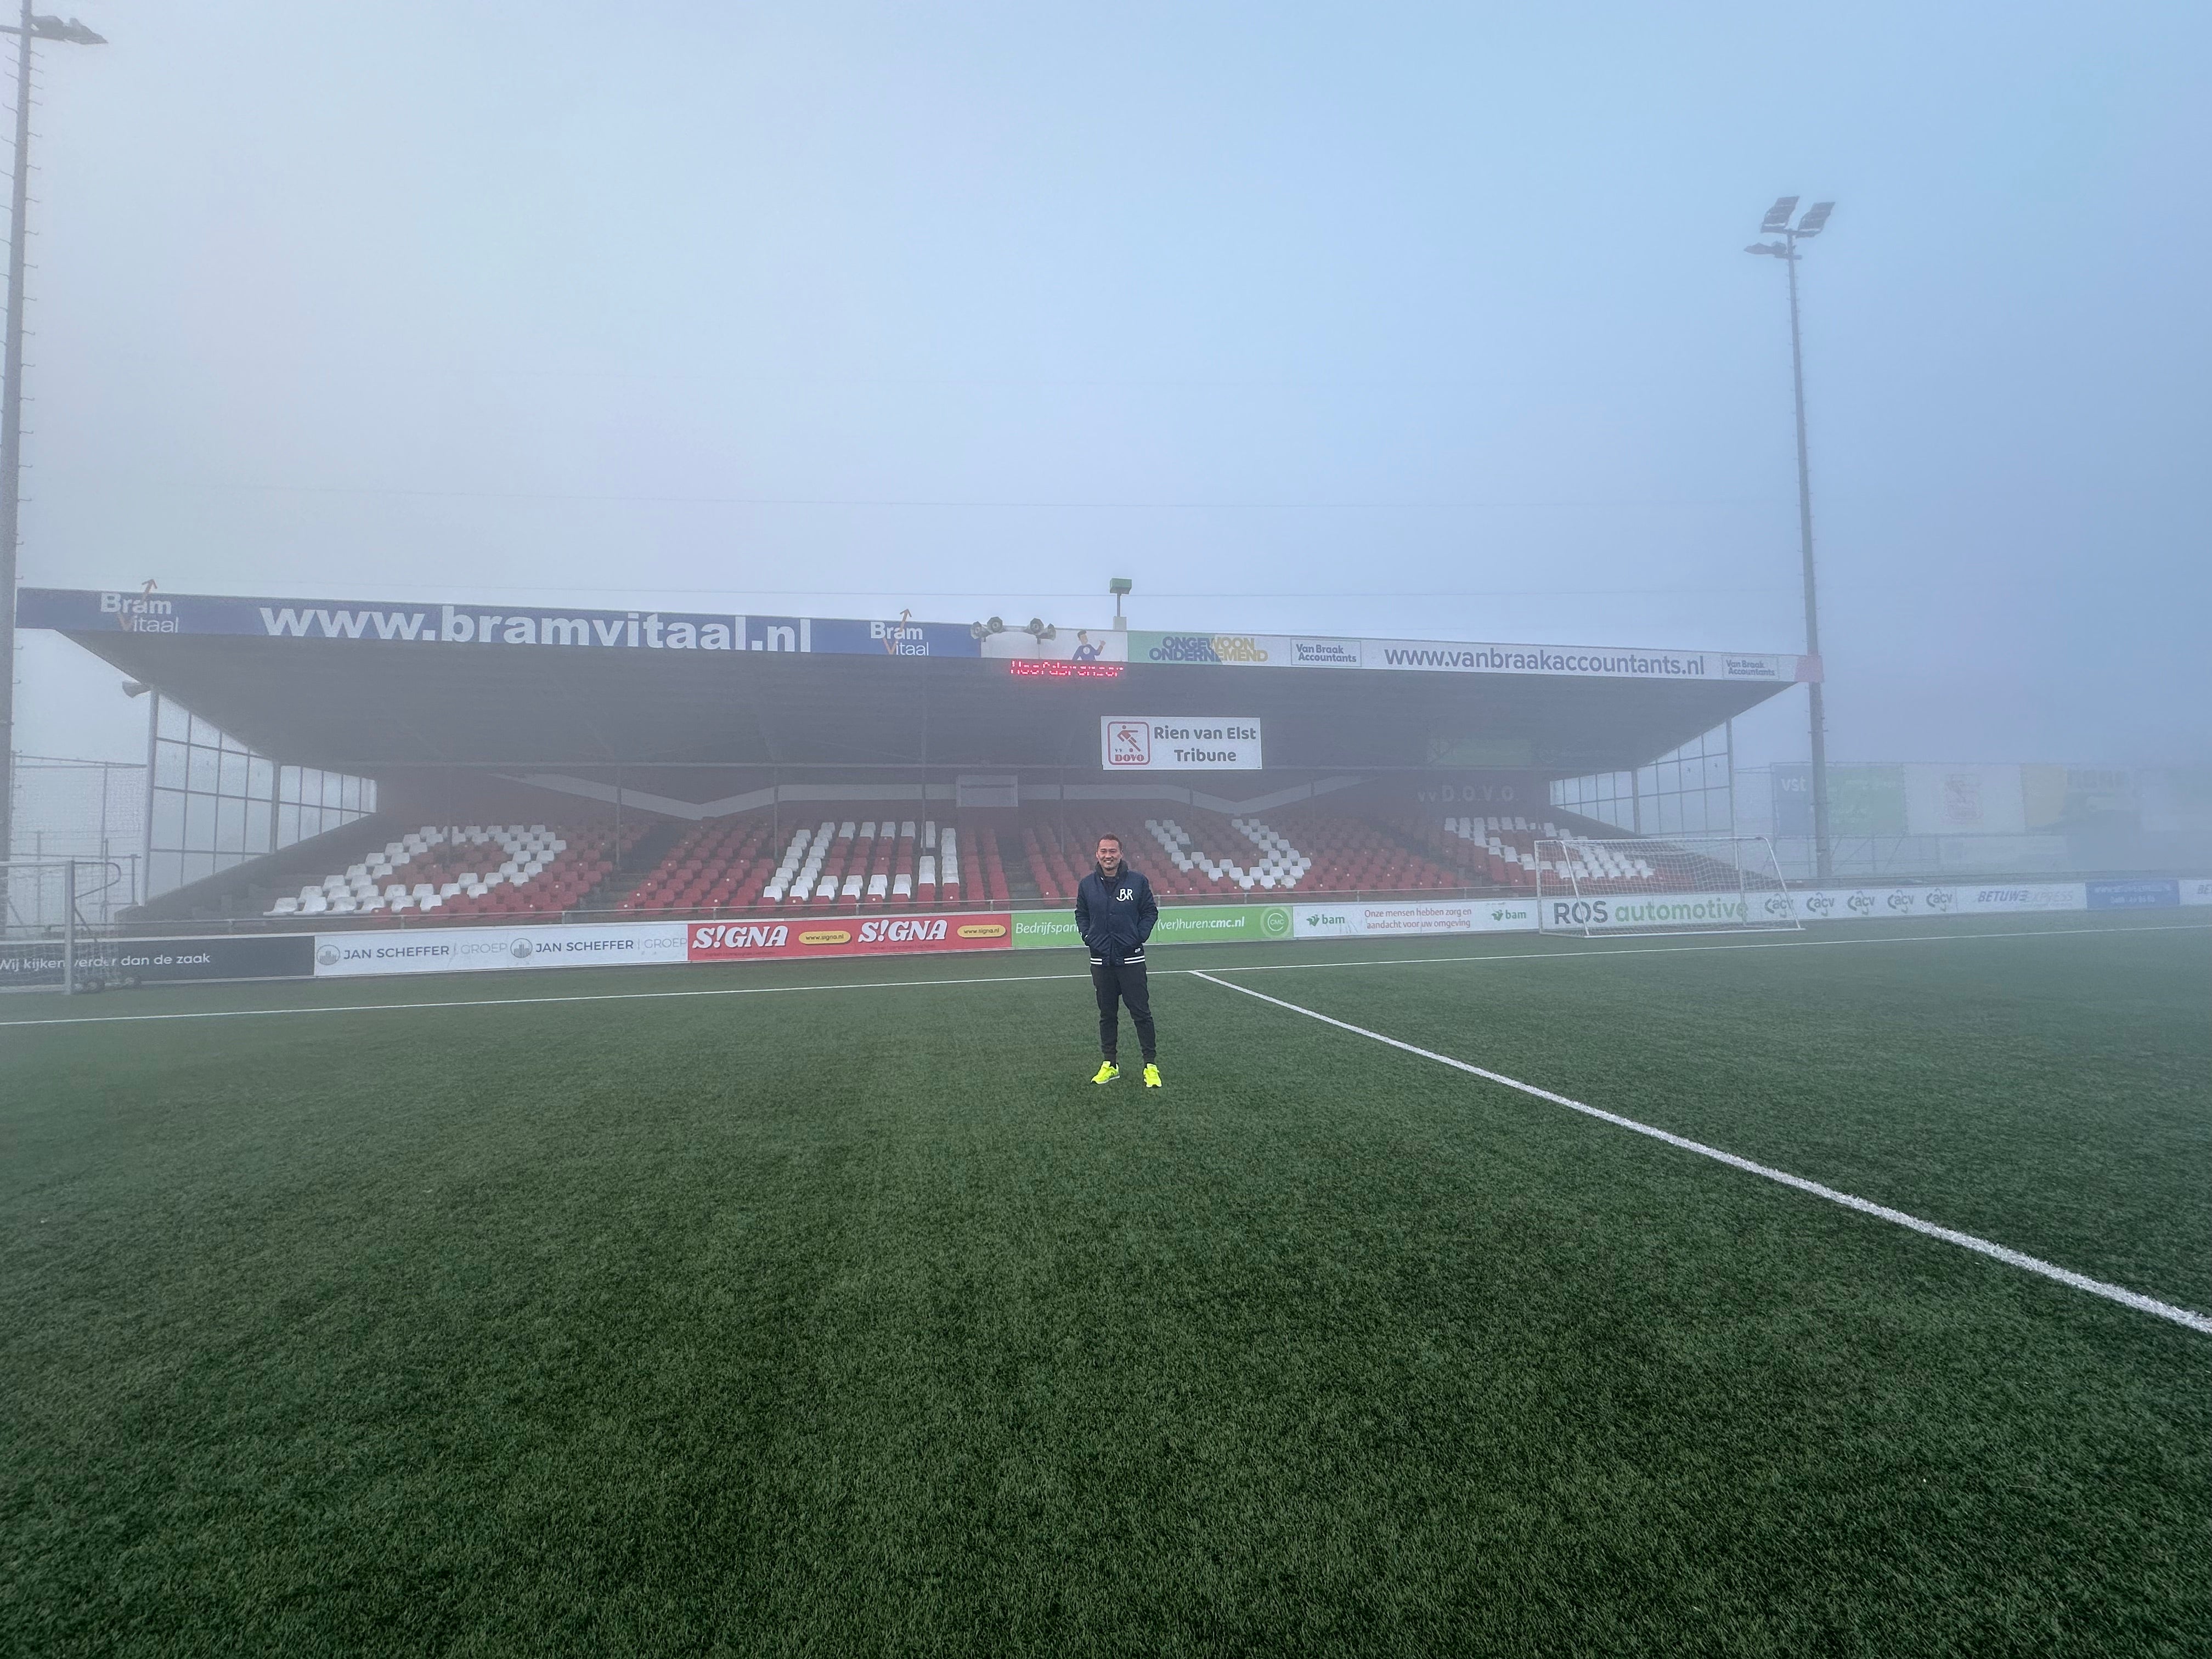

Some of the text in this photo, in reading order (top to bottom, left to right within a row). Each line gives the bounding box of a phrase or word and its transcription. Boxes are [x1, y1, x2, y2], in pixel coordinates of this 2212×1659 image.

[100, 592, 171, 614] Bram
[117, 611, 179, 633] Vitaal
[259, 605, 811, 653] www.bramvitaal.nl
[870, 620, 923, 640] Bram
[883, 637, 929, 656] Vitaal
[1162, 636, 1255, 651] ONGEWOON
[1296, 644, 1344, 654] Van Braak
[1148, 648, 1269, 663] ONDERNEMEND
[1298, 653, 1357, 663] Accountants
[1384, 647, 1705, 675] www.vanbraakaccountants.nl
[1726, 659, 1765, 669] Van Braak
[1728, 667, 1775, 677] Accountants
[1154, 725, 1256, 740] Rien van Elst
[1115, 754, 1144, 762] DOVO
[1174, 748, 1237, 762] Tribune
[1116, 888, 1133, 901] BR
[1322, 914, 1345, 924] bam
[1364, 909, 1384, 918] Onze
[1417, 908, 1444, 916] hebben
[1445, 909, 1462, 918] zorg
[1505, 909, 1527, 919] bam
[1554, 899, 1748, 925] ROS automotive
[1158, 916, 1245, 931] (ver)huren:cmc.nl
[1367, 919, 1402, 929] aandacht
[1434, 919, 1470, 929] omgeving
[963, 927, 1000, 936] www.signa.nl
[343, 943, 508, 960] JAN SCHEFFER GROEP
[535, 937, 687, 953] JAN SCHEFFER GROEP
[121, 955, 150, 966] dan
[153, 953, 172, 965] de
[176, 953, 211, 964] zaak
